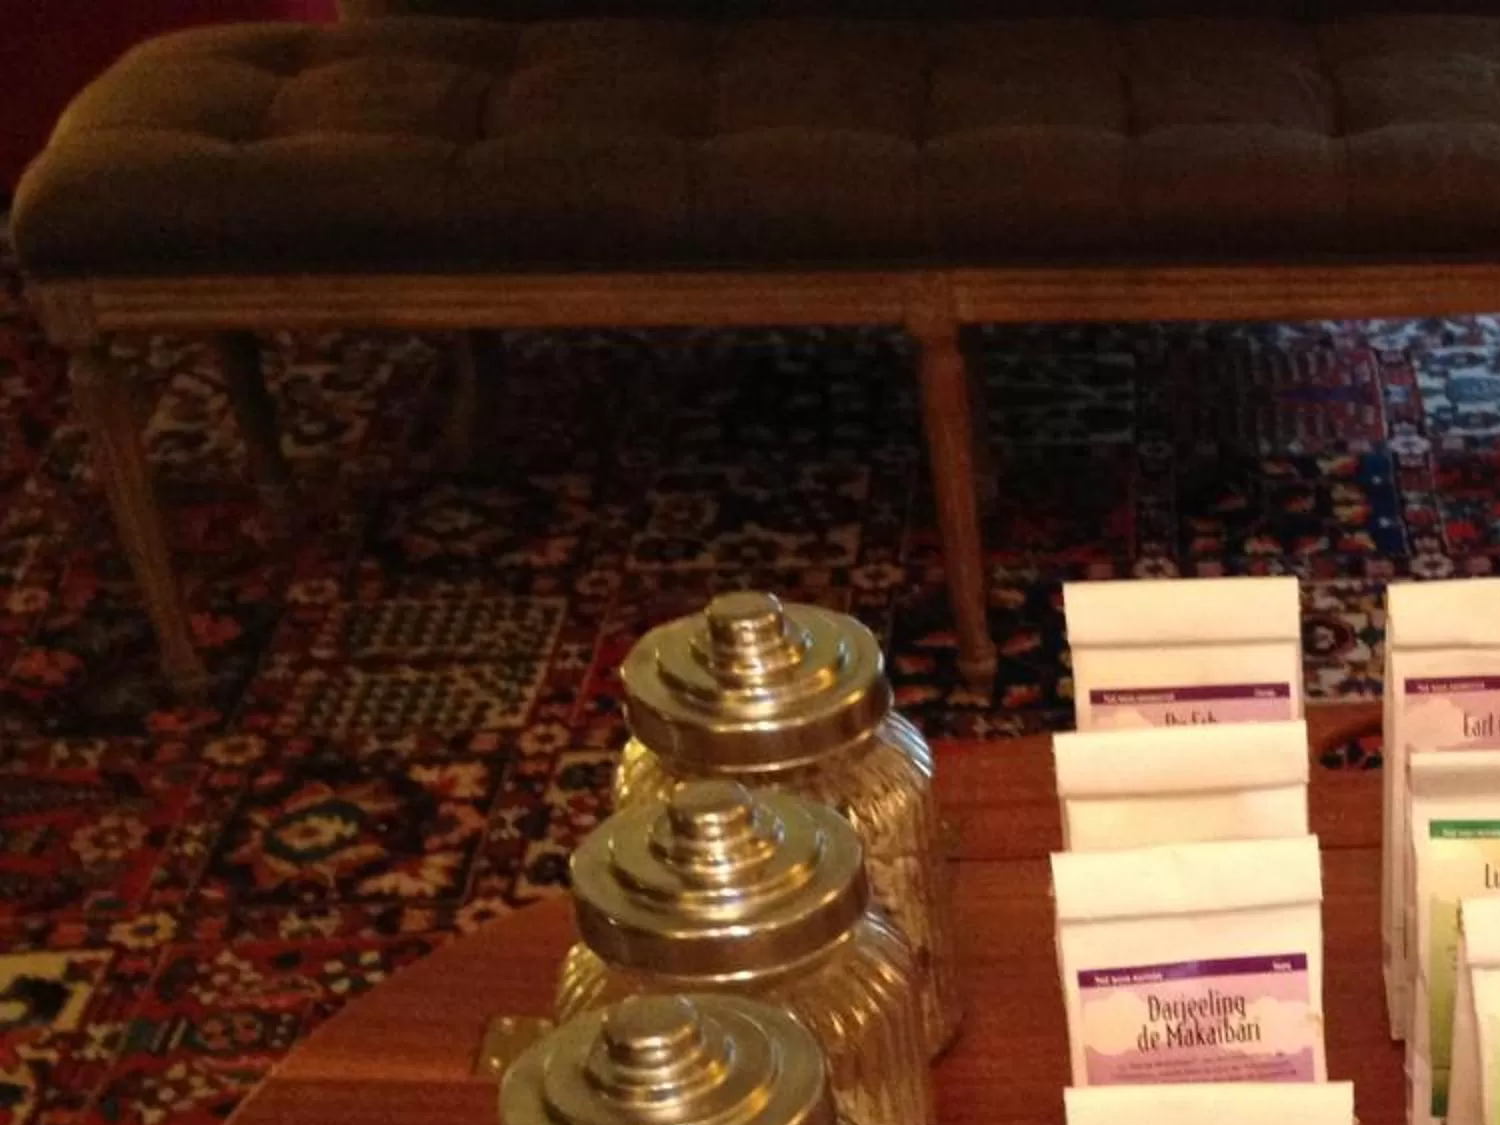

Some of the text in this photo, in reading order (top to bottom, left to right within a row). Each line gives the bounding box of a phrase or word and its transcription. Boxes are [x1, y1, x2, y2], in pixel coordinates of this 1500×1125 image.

[1463, 711, 1493, 737] Earl
[1148, 988, 1246, 1022] Darjeeling
[1137, 1016, 1261, 1052] de Makaibari
